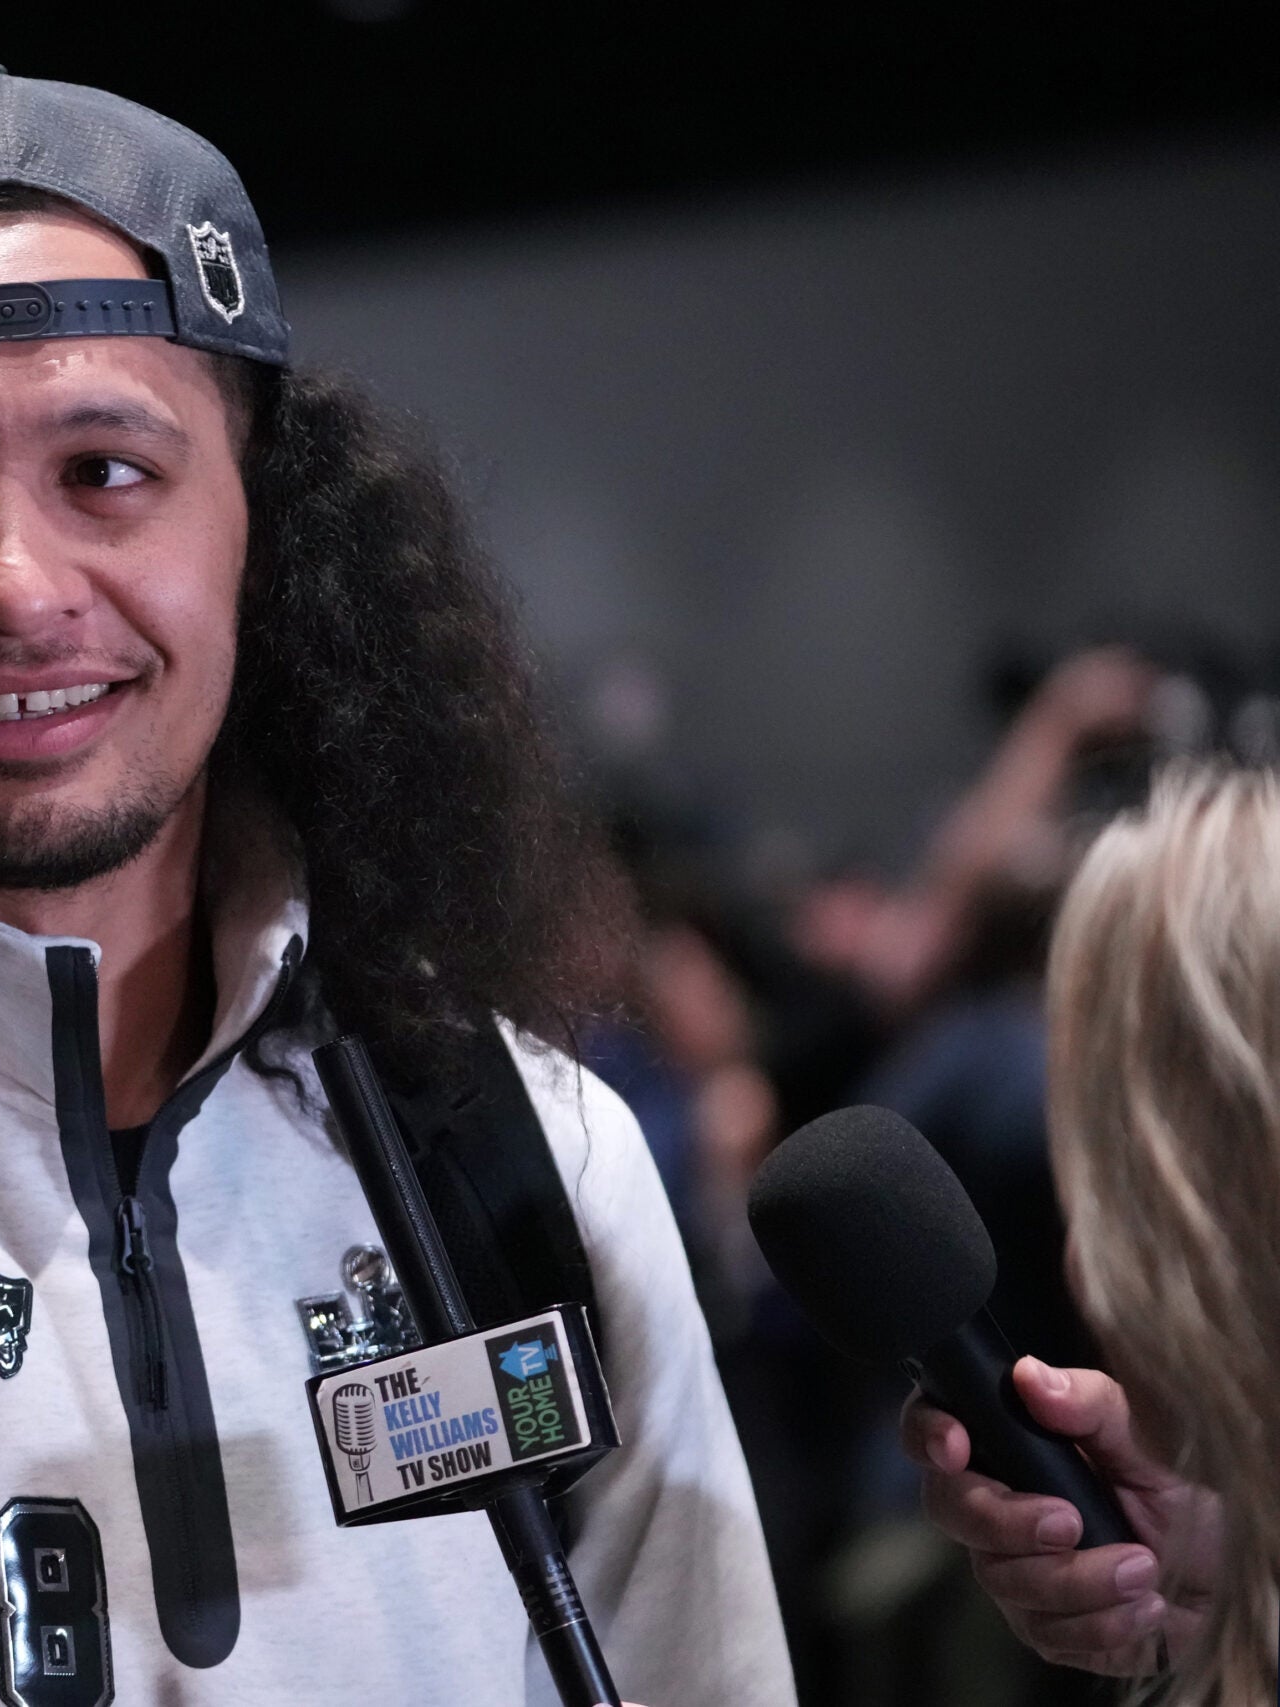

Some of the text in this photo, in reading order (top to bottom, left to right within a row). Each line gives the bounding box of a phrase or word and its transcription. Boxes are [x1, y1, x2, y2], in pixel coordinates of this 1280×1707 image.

[374, 1367, 421, 1403] THE
[518, 1346, 565, 1444] HOME TV
[383, 1390, 441, 1432] KELLY
[389, 1407, 499, 1461] WILLIAMS
[507, 1384, 540, 1451] YOUR
[396, 1441, 493, 1490] TV SHOW
